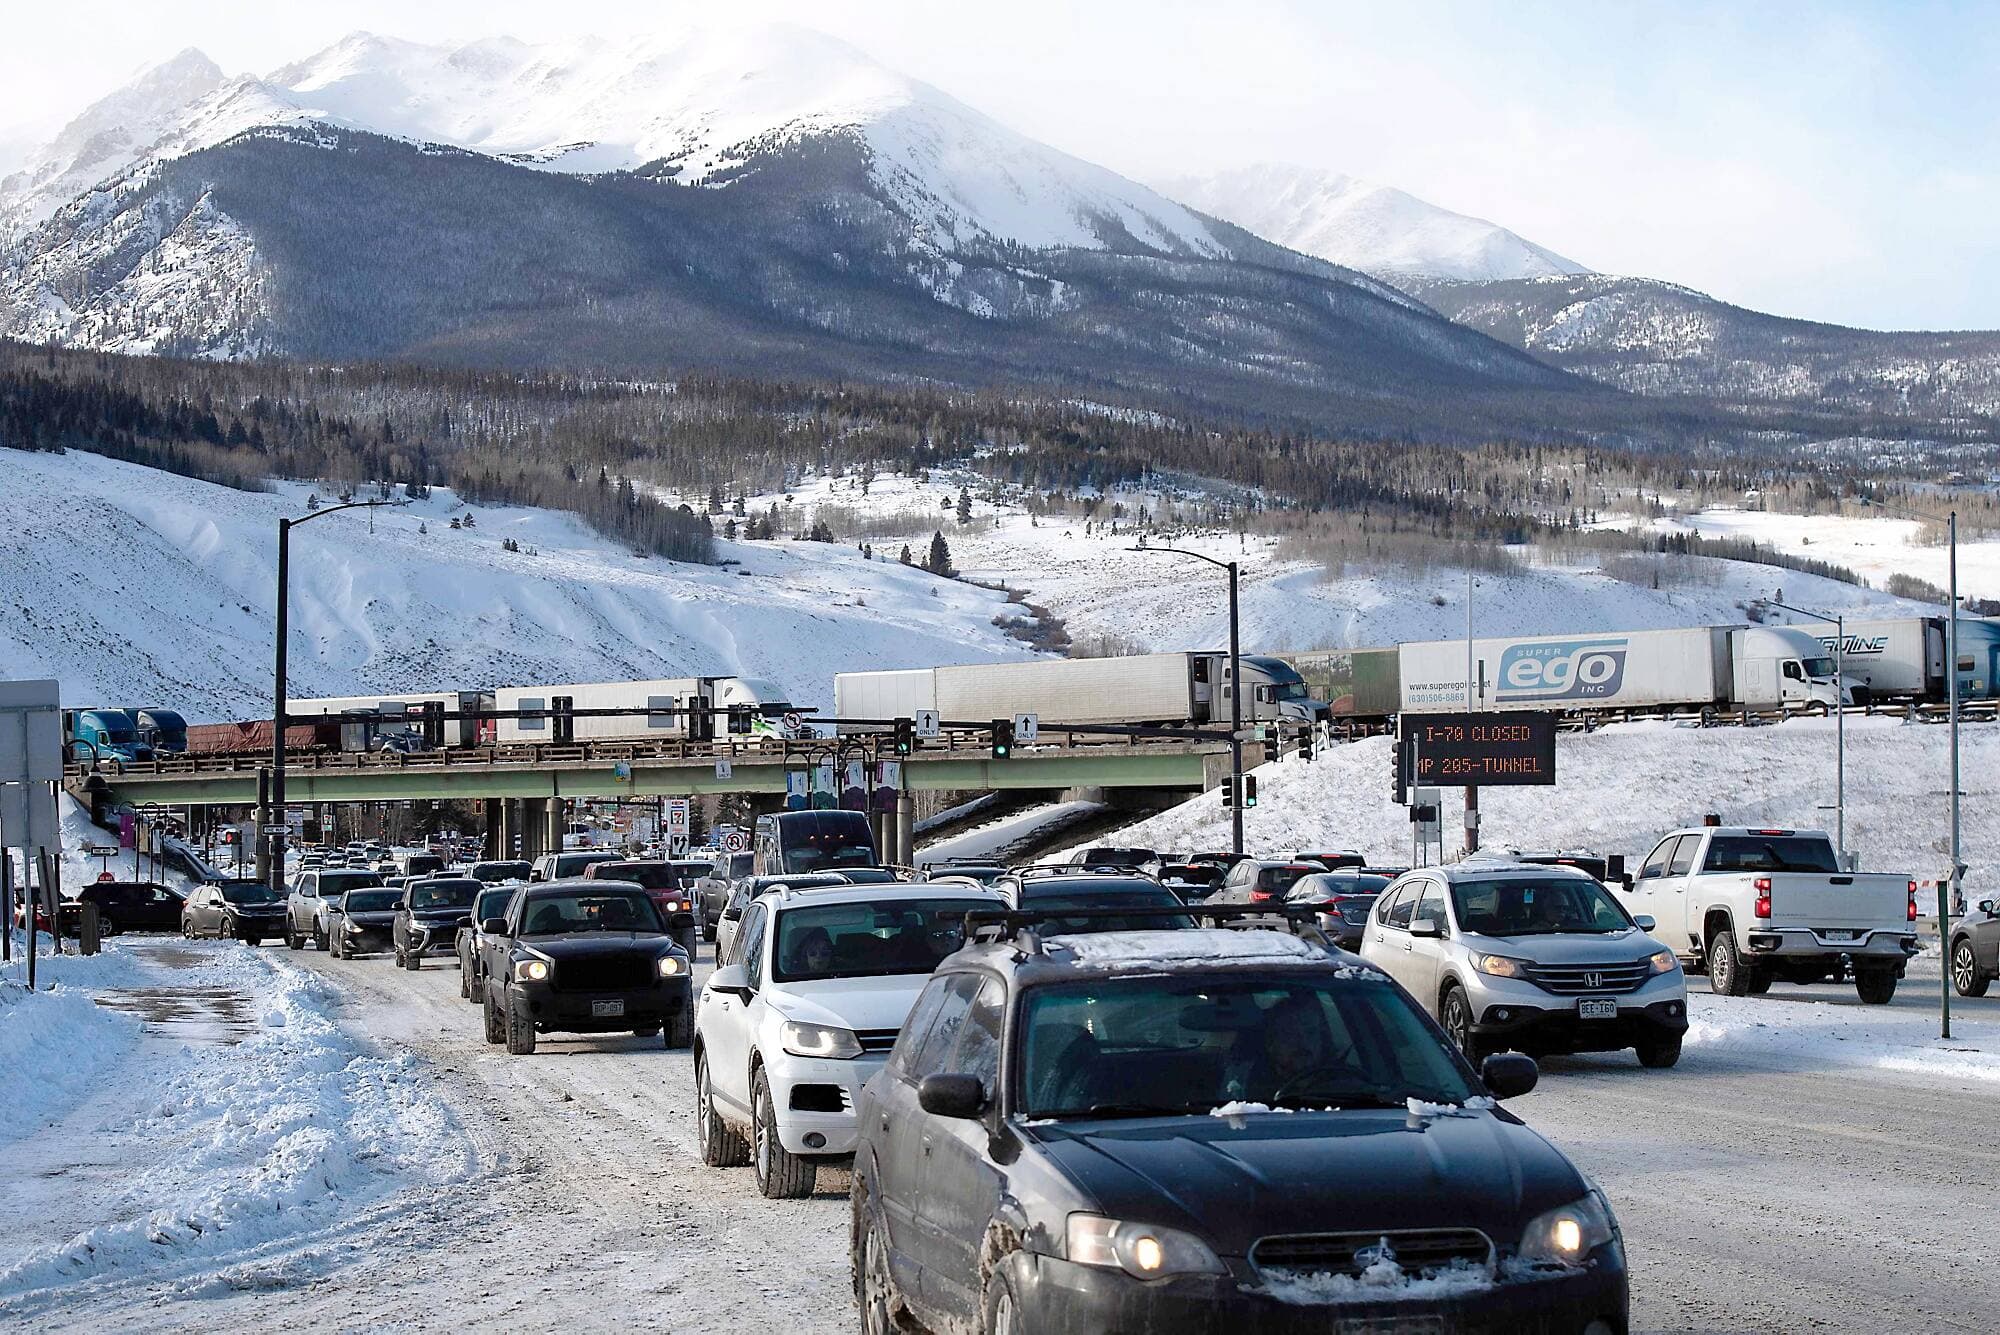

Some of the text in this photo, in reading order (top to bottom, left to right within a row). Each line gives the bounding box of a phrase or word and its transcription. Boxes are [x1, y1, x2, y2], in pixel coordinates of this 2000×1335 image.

[1517, 648, 1562, 657] SUPER
[1507, 653, 1617, 691] ego
[1408, 680, 1491, 691] www.superegoic.et
[1581, 685, 1605, 693] INC
[1426, 725, 1531, 742] I-70 CLOSED
